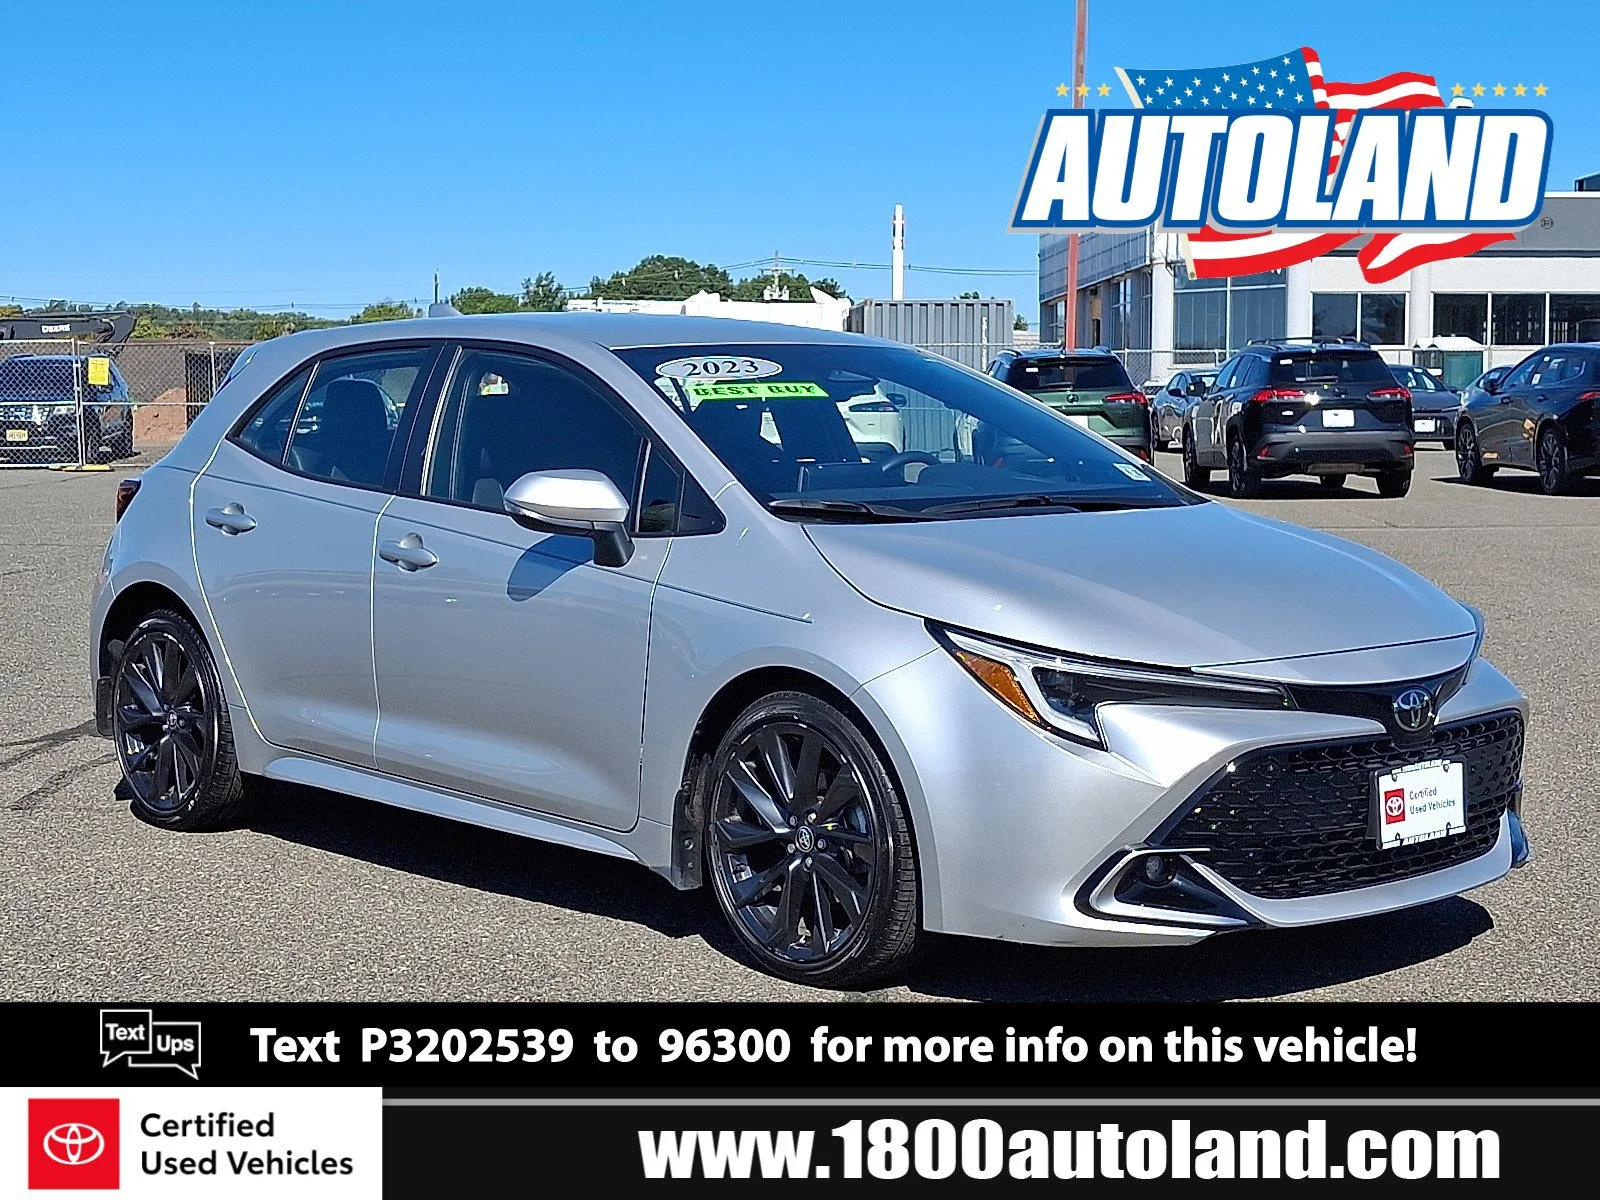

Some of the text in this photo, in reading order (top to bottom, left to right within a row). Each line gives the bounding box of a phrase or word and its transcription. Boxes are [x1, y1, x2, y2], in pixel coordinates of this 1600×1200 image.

[682, 360, 760, 377] 2023
[693, 385, 817, 396] BEST BUY
[1409, 787, 1438, 801] Certified
[1409, 798, 1456, 815] Used Vehicles
